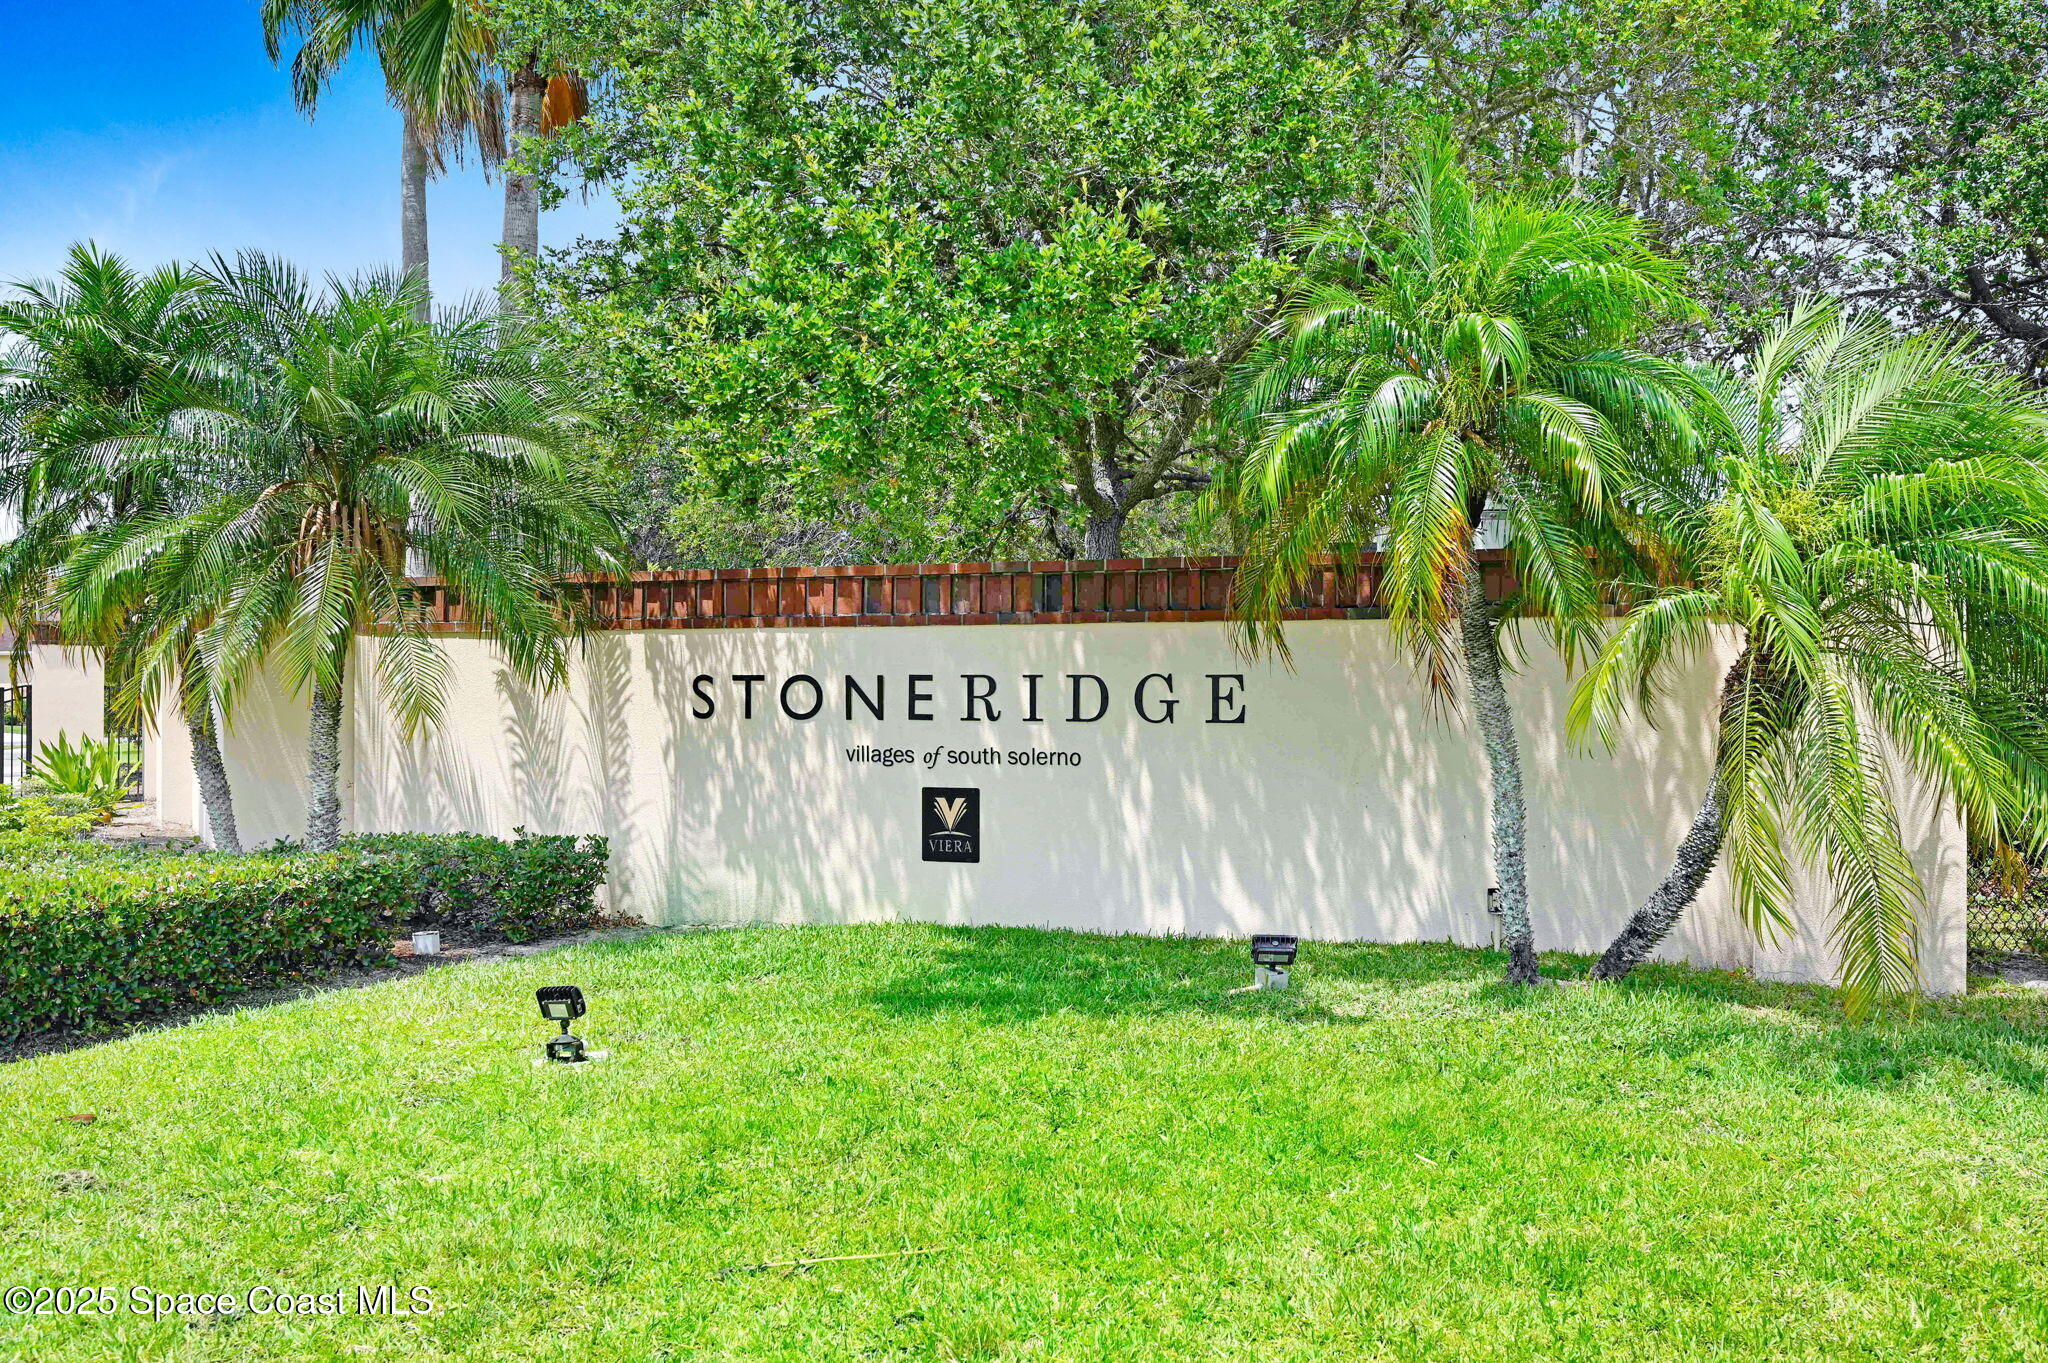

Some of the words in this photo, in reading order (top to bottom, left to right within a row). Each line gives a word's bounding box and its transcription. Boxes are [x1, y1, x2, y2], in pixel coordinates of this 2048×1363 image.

[692, 673, 1247, 724] STONERIDGE
[846, 745, 915, 767] villages
[923, 745, 942, 769] of
[947, 746, 1001, 766] south
[1007, 747, 1082, 767] solerno
[929, 839, 972, 853] VIERA
